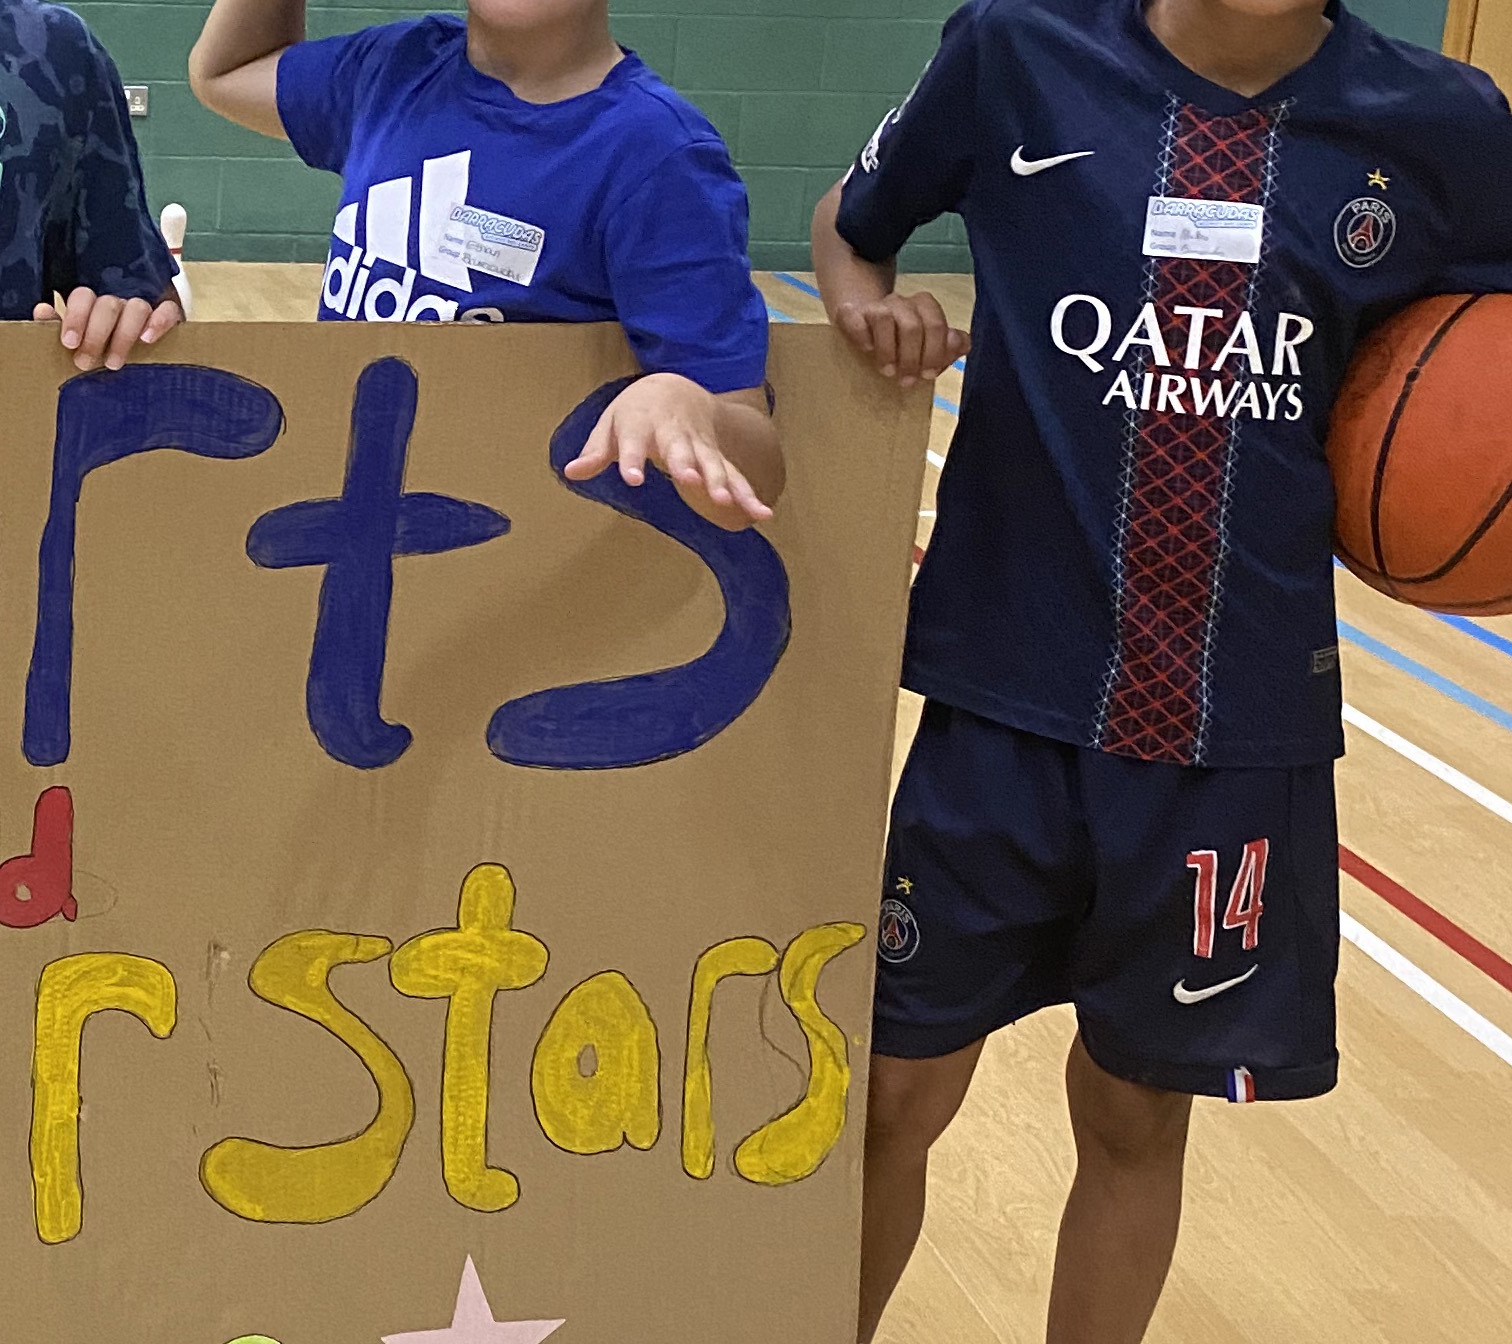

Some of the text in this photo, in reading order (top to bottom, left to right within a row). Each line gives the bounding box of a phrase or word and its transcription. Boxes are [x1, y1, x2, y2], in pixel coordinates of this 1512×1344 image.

[450, 206, 542, 246] BARRACUDAS
[1151, 200, 1259, 221] BARRACUDAS
[1351, 201, 1392, 224] PARIS
[1050, 294, 1314, 376] QATAR
[1101, 369, 1303, 421] AIRWAYS
[1186, 838, 1270, 958] 14
